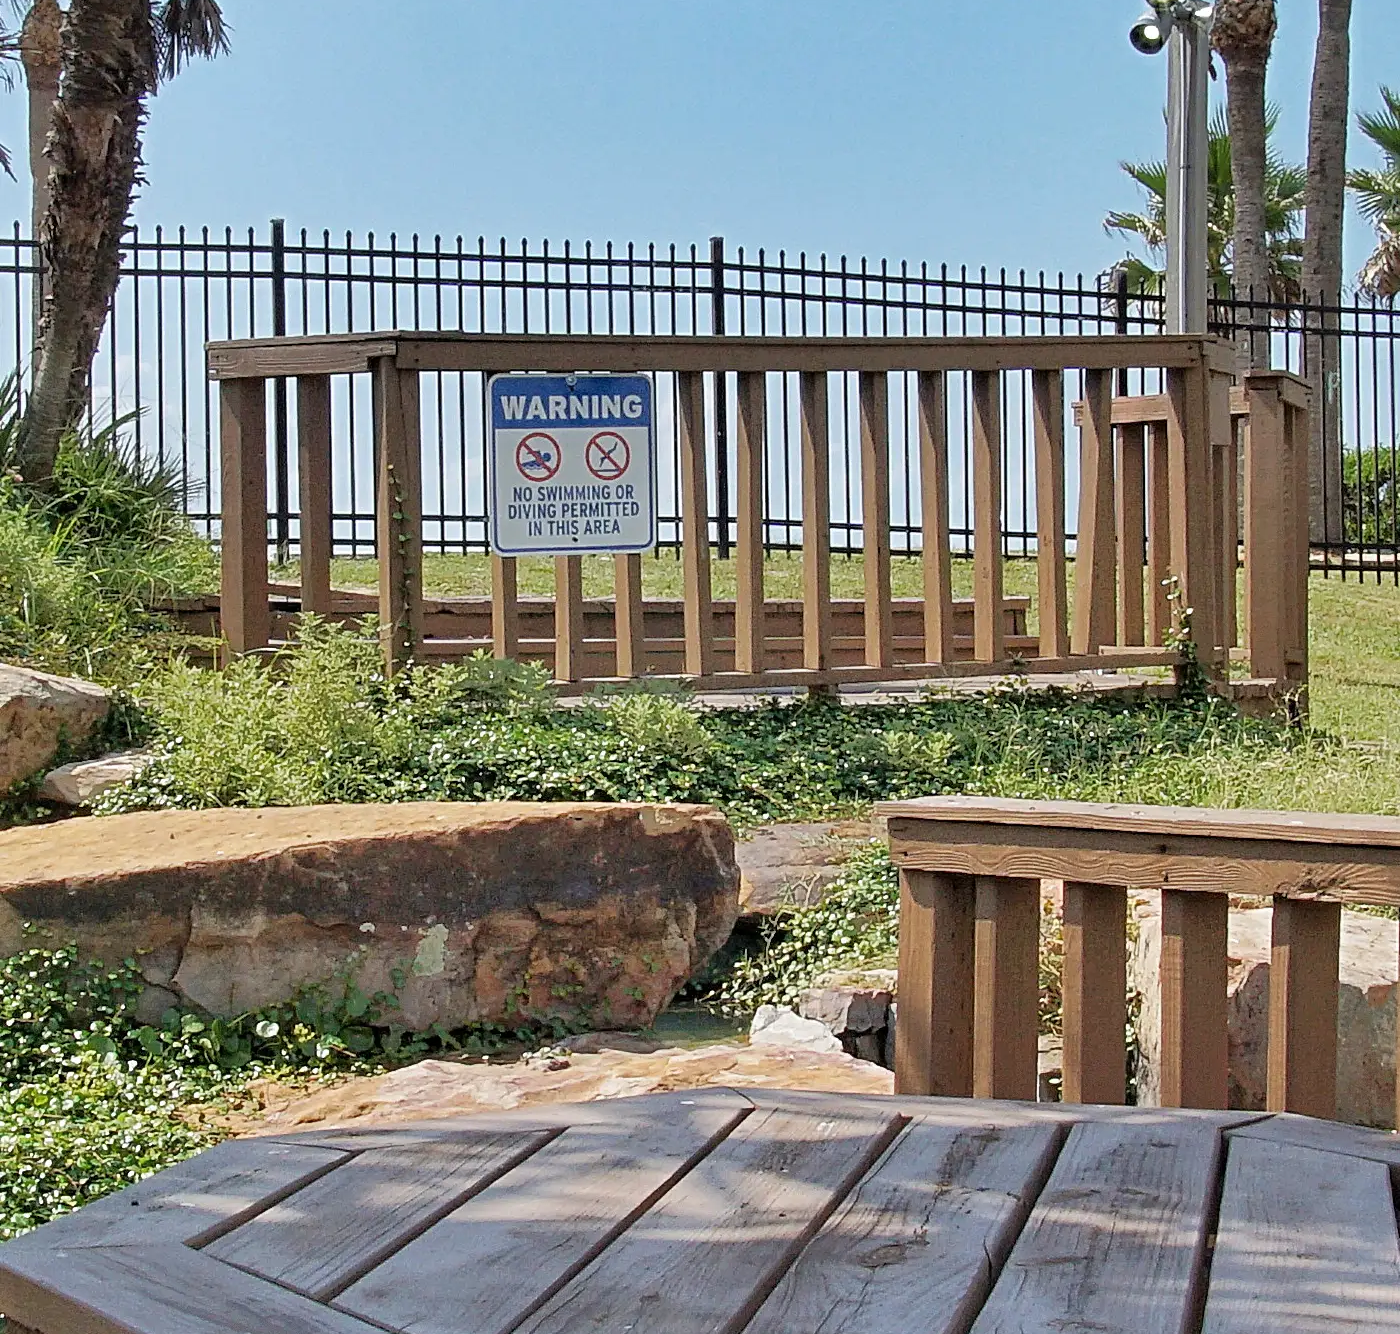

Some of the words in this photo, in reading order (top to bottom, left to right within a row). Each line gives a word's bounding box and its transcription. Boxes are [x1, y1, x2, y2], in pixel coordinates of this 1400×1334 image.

[501, 395, 642, 420] WARNING
[513, 487, 532, 502] NO
[538, 485, 610, 501] SWIMMING
[616, 485, 634, 499] OR
[508, 504, 556, 519] DIVING
[562, 501, 639, 517] PERMITTED
[529, 521, 542, 536] IN
[549, 520, 579, 535] THIS
[584, 519, 620, 535] AREA
